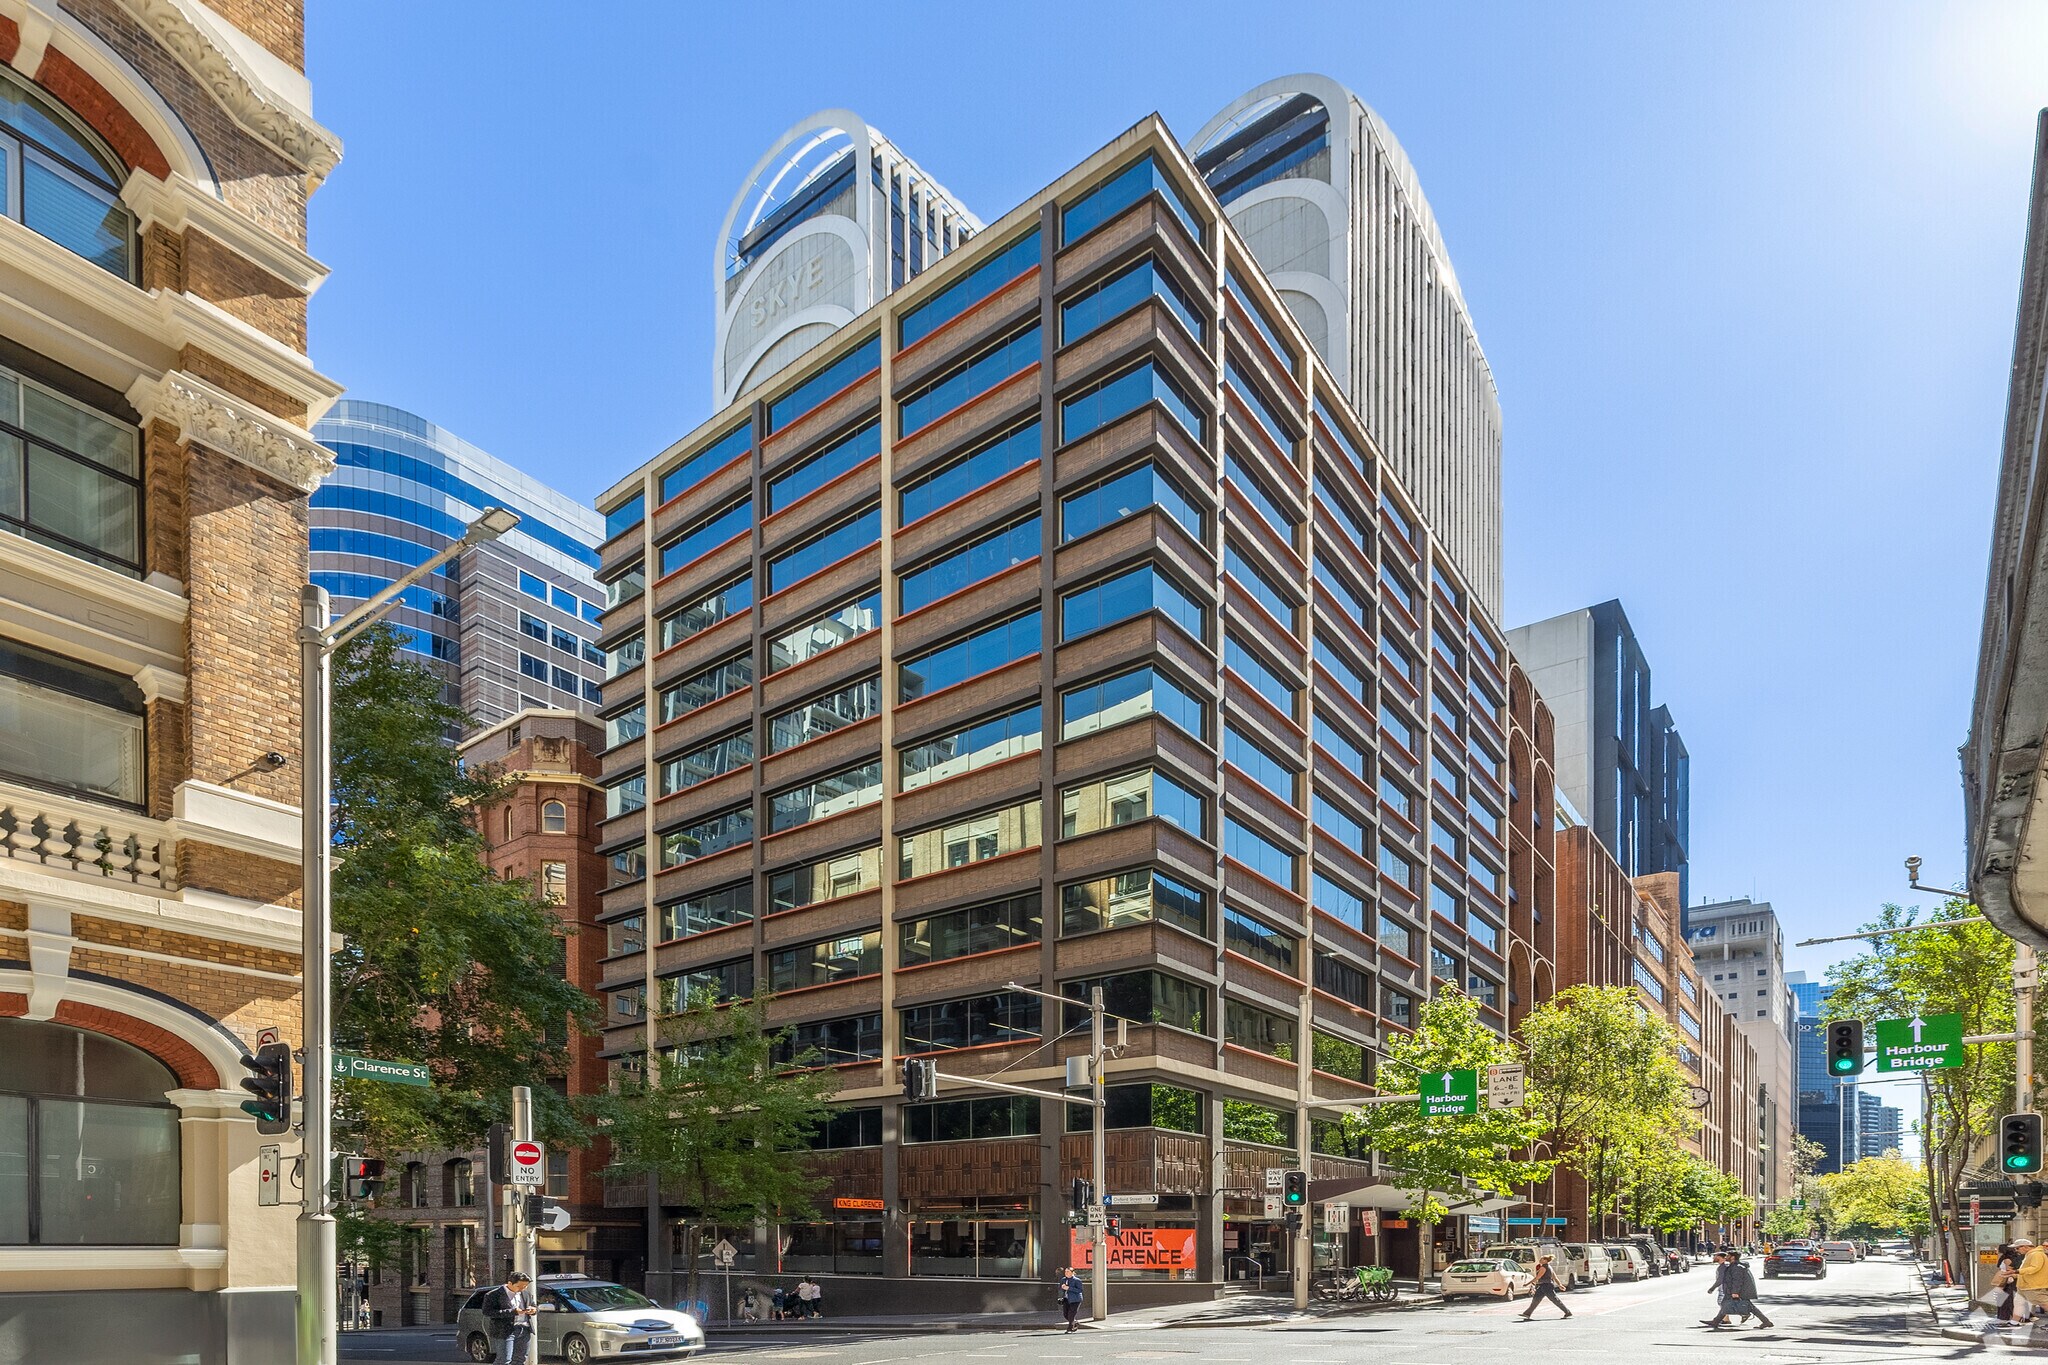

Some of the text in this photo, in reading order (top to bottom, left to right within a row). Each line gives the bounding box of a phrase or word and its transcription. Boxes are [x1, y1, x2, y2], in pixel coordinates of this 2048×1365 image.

[751, 257, 823, 328] SKYE
[1886, 1044, 1949, 1055] Harbour
[1891, 1057, 1944, 1067] Bridge
[353, 1060, 427, 1079] Clarence St
[1426, 1095, 1469, 1103] Harbour
[1429, 1105, 1465, 1114] Bridge
[1115, 1232, 1153, 1246] KING
[1086, 1250, 1181, 1264] CARENCE
